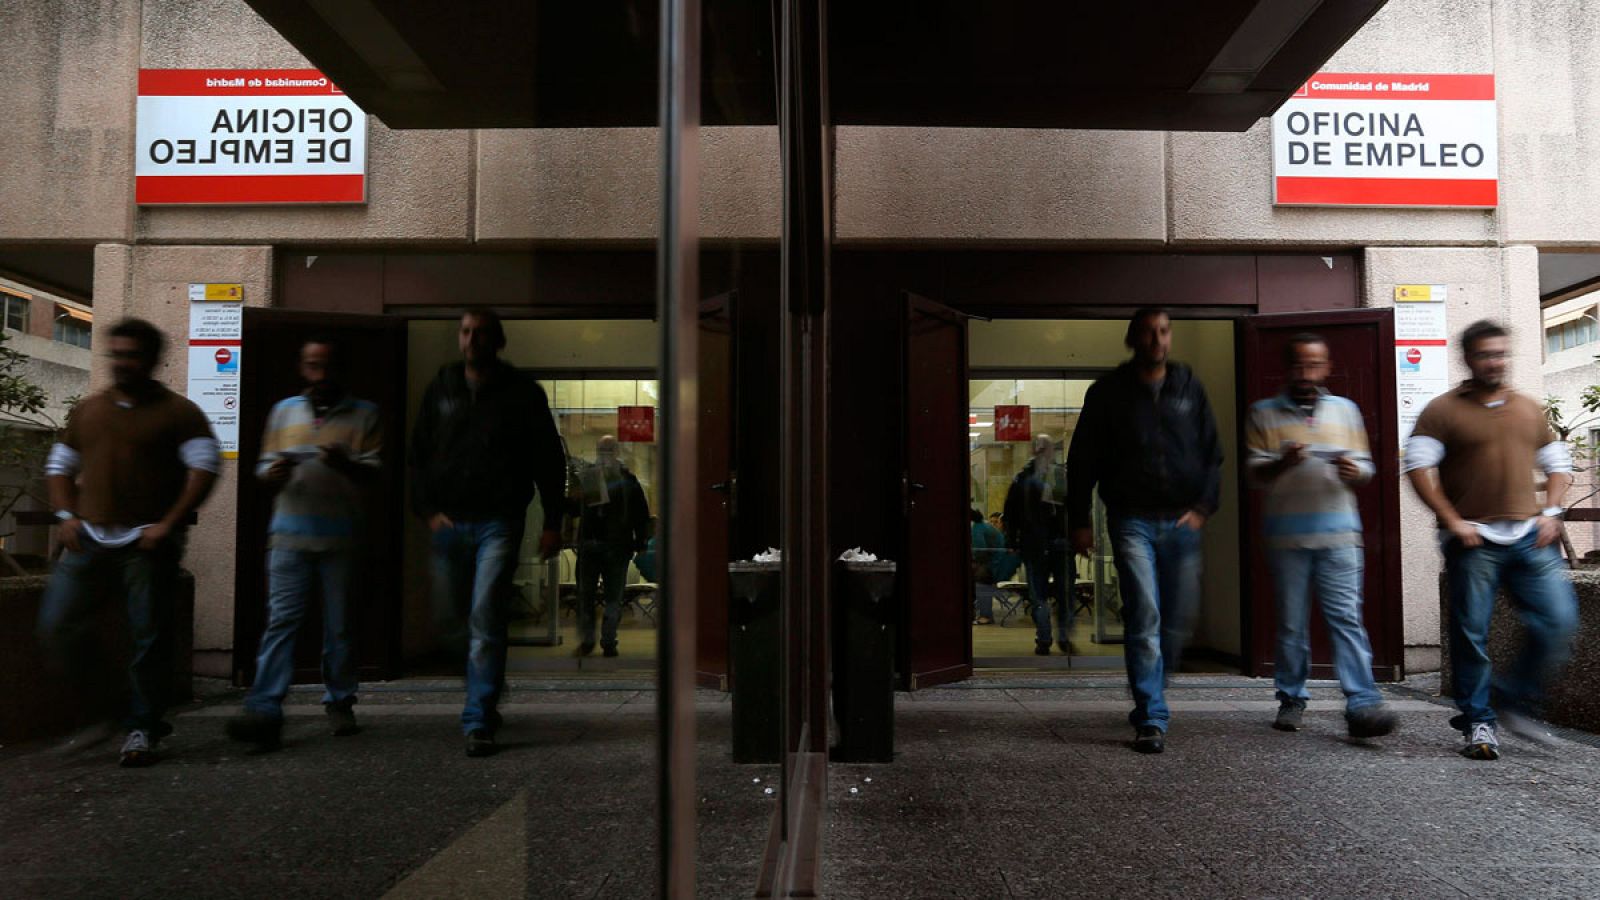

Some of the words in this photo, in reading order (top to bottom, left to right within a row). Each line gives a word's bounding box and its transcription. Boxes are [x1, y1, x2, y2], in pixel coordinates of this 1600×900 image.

[1311, 81, 1373, 91] Comunidad
[1375, 81, 1389, 91] de
[1391, 82, 1430, 92] Madrid
[1287, 111, 1425, 137] OFICINA
[1288, 141, 1332, 165] DE
[1345, 142, 1484, 168] EMPLEO
